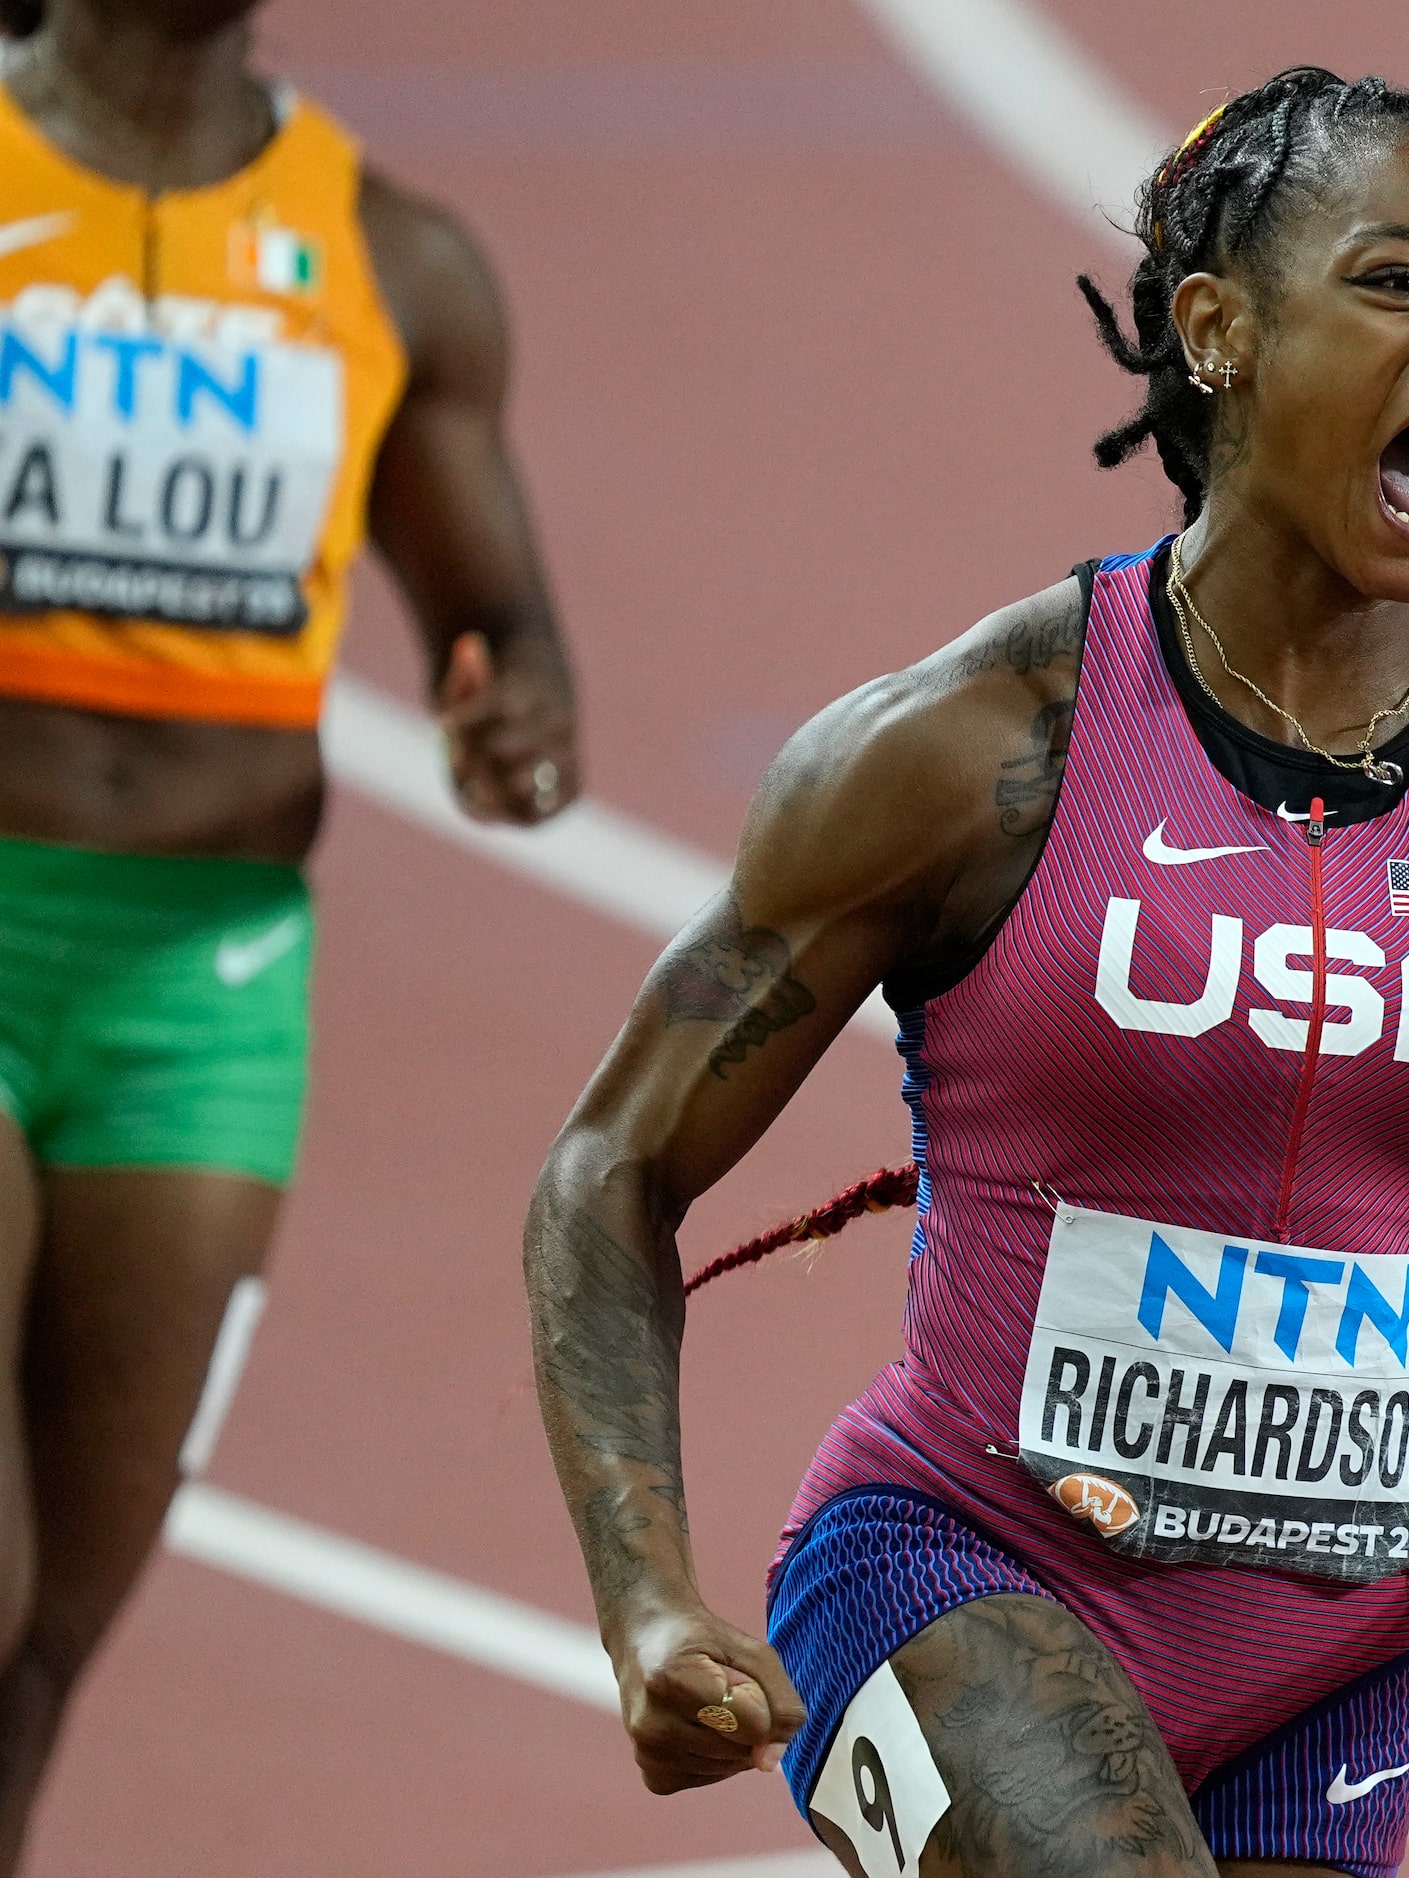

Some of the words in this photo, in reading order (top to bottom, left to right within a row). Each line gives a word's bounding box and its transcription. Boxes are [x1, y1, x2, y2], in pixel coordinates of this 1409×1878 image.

[0, 327, 258, 437] NTN
[103, 450, 284, 546] LOU
[1153, 1503, 1385, 1557] BUDAPEST
[851, 1735, 906, 1875] 9
